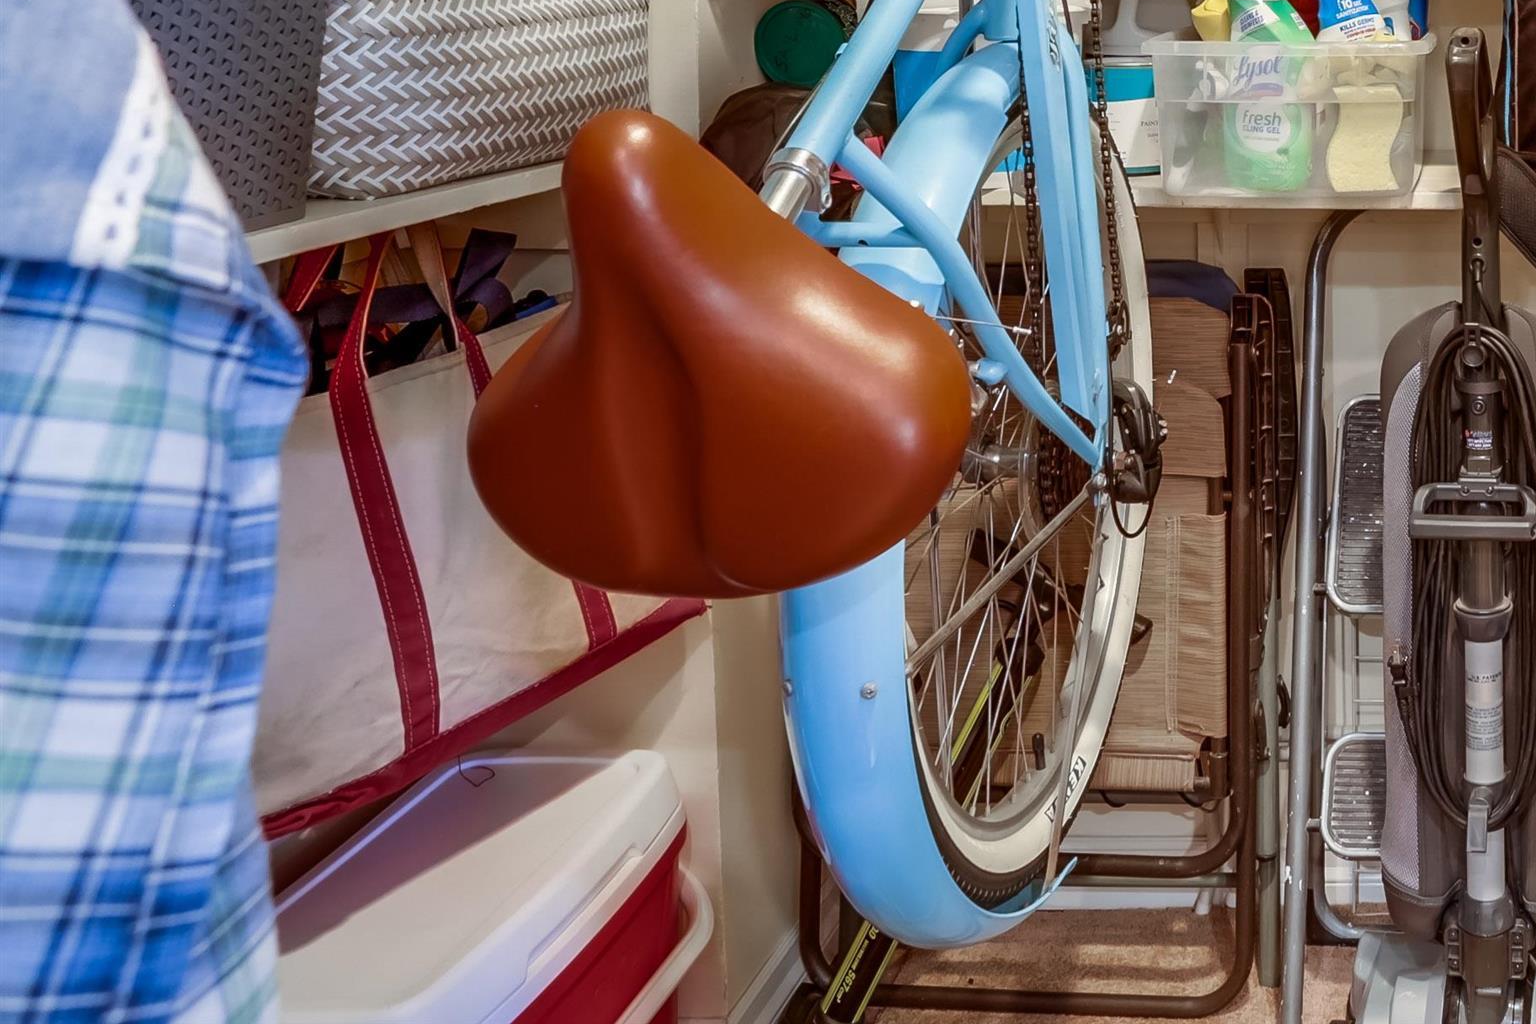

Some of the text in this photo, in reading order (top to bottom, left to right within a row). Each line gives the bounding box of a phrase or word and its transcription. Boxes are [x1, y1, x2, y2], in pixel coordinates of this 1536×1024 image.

[1341, 0, 1352, 9] 10
[1340, 21, 1356, 32] KILLS
[1233, 55, 1283, 88] Lysol
[1242, 110, 1281, 126] fresh
[1266, 126, 1281, 134] GEL
